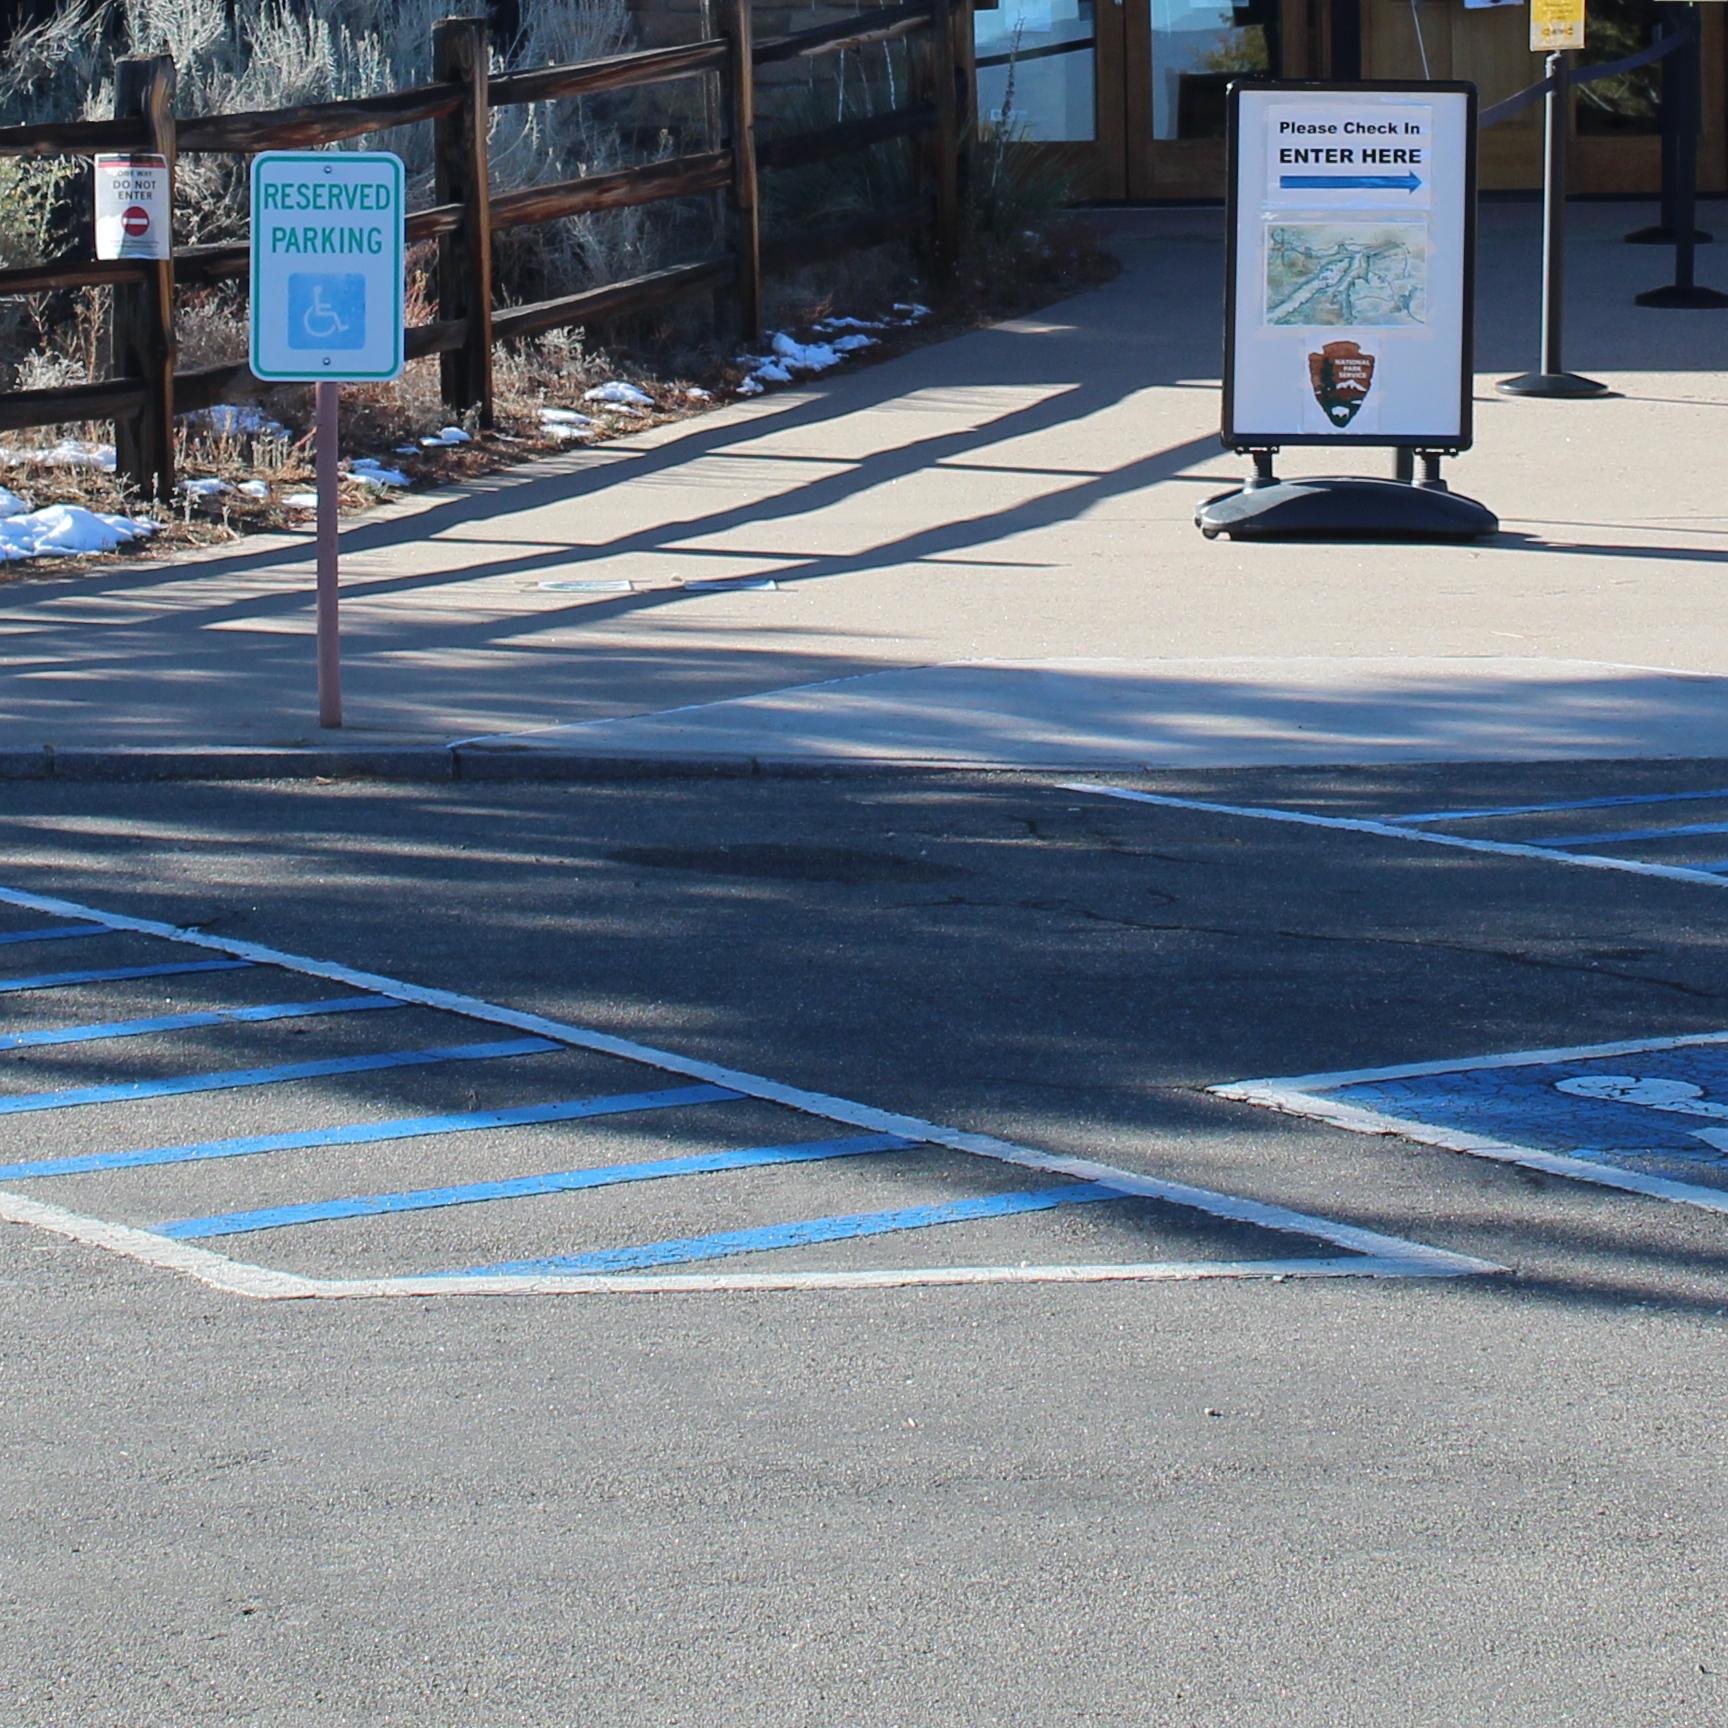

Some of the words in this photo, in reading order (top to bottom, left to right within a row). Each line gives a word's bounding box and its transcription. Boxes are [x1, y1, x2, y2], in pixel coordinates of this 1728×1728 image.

[1279, 121, 1338, 135] Please
[1343, 121, 1398, 135] Check
[1404, 122, 1421, 135] In
[1279, 148, 1354, 164] ENTER
[1362, 148, 1421, 164] HERE
[113, 180, 131, 190] DO
[135, 180, 156, 190] NOT
[118, 191, 153, 201] ENTER
[263, 183, 391, 211] RESERVED
[271, 226, 383, 256] PARKING
